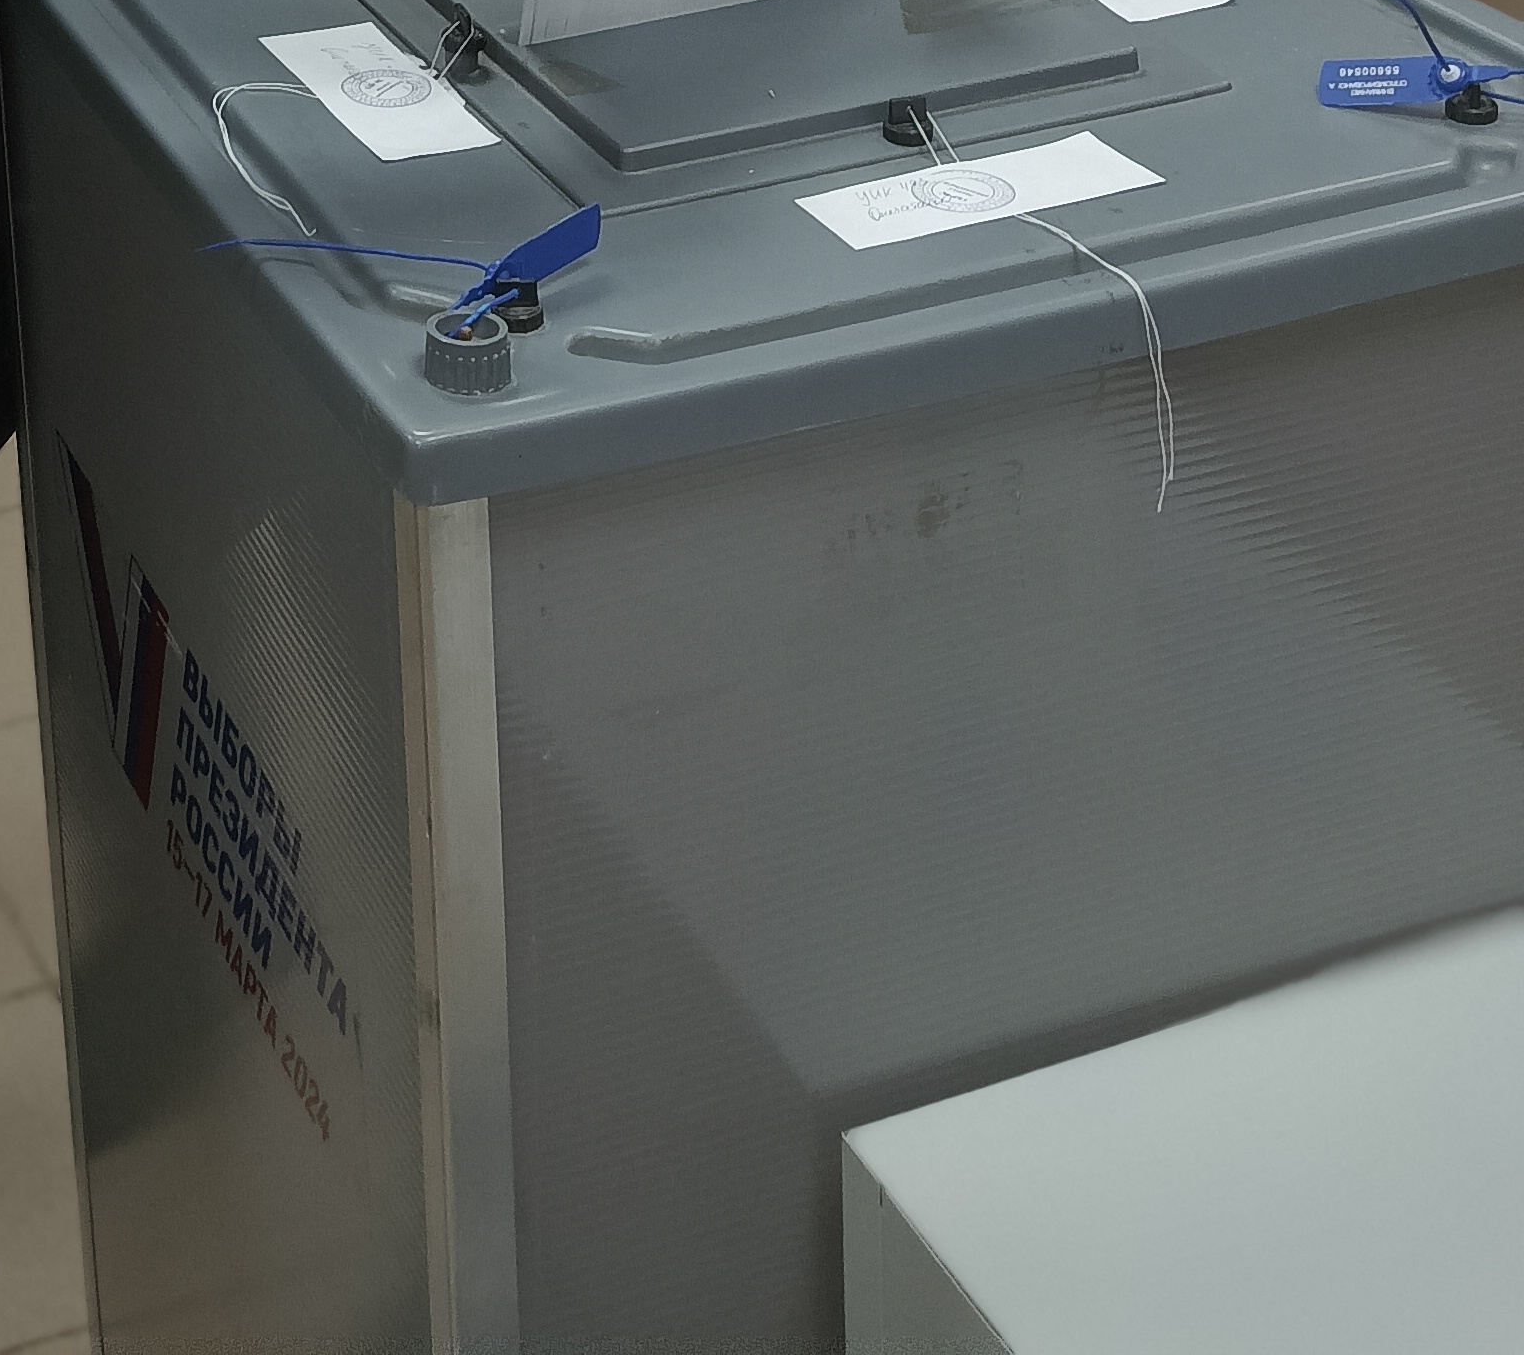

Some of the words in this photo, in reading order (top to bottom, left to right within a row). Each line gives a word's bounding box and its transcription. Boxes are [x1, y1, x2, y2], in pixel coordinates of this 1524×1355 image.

[169, 762, 274, 971] РОССИИ
[176, 705, 347, 1036] ПРЕЗИДЕНТА
[182, 647, 303, 874] ВЫБОРЫ
[215, 908, 278, 1049] МАРТА
[280, 1033, 332, 1143] 2024
